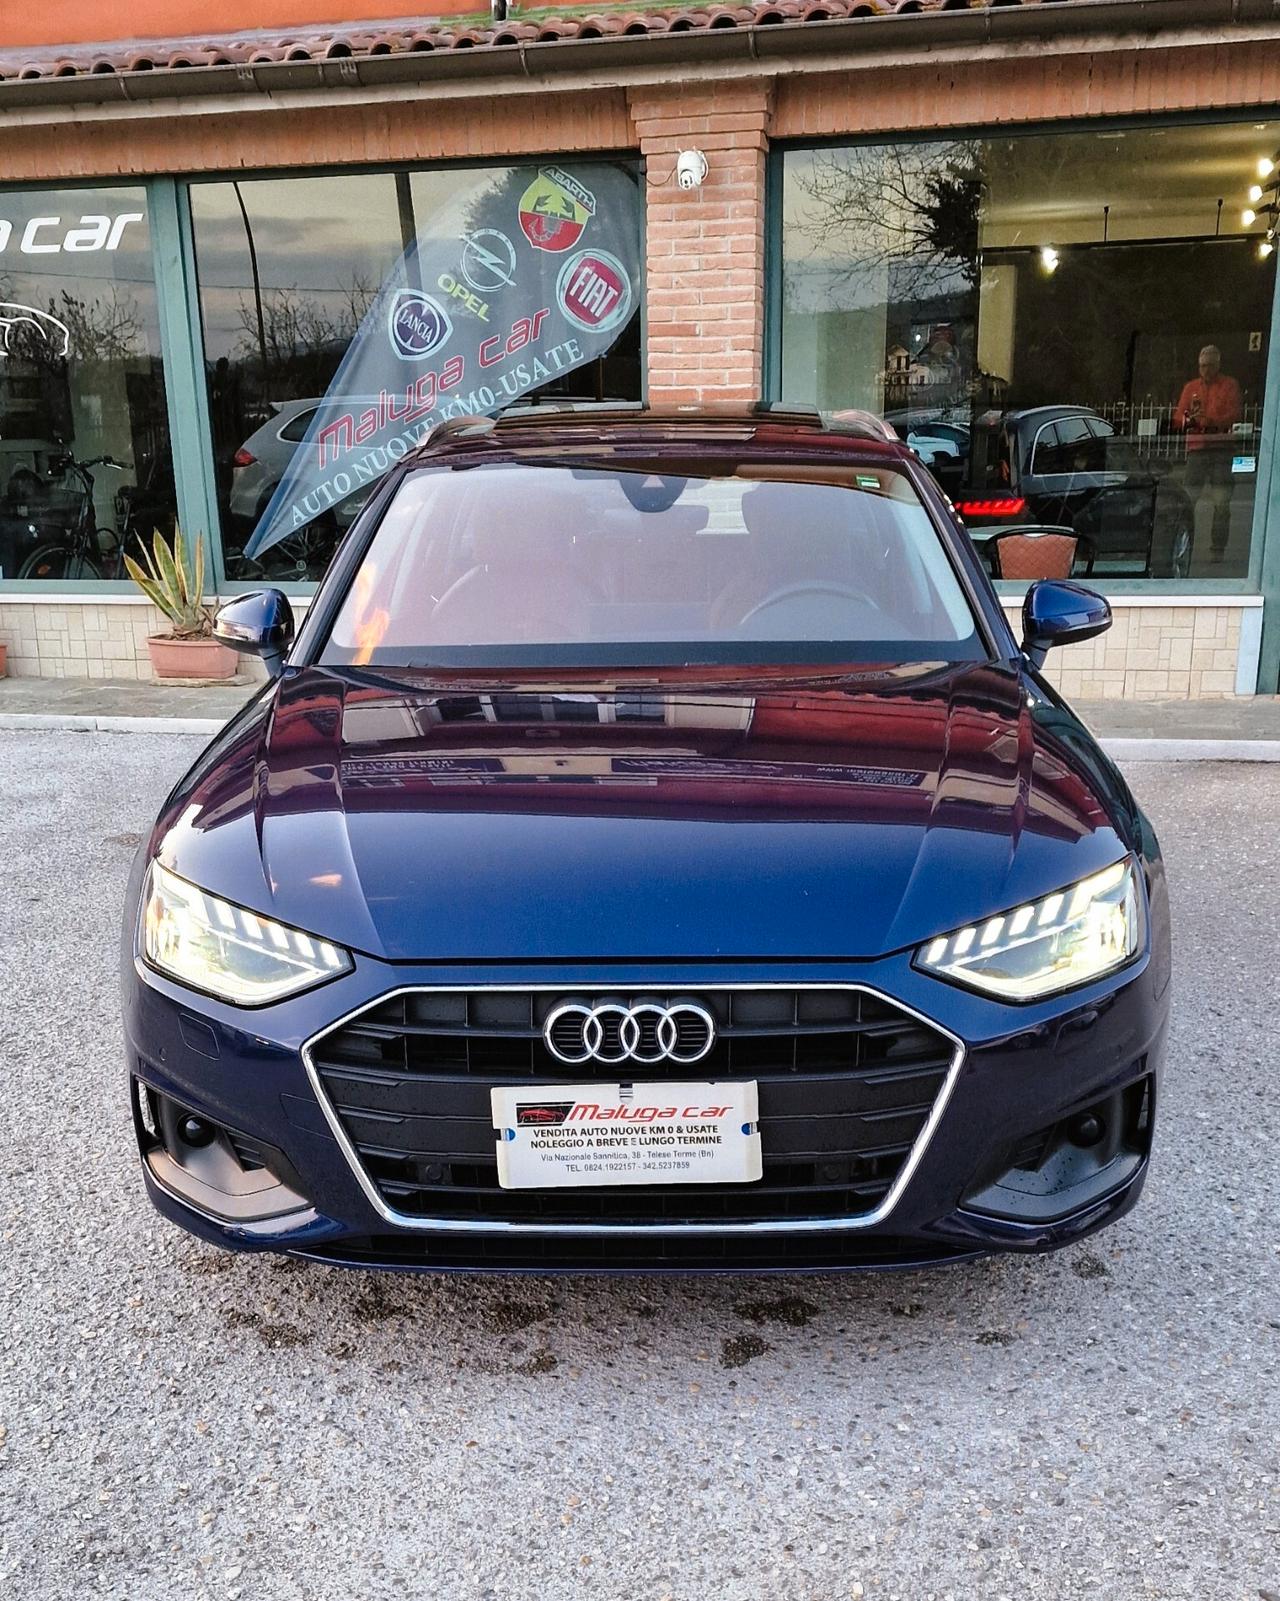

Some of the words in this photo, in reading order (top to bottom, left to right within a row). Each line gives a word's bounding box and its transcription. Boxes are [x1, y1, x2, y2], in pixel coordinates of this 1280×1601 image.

[545, 168, 593, 208] ABARTH
[20, 213, 144, 253] car
[437, 273, 490, 322] OPEL
[569, 266, 618, 318] FIAT
[398, 308, 433, 344] LANCIA
[318, 354, 465, 471] Maluga
[479, 307, 550, 369] car
[289, 472, 352, 526] AUTO
[533, 1128, 577, 1138] VENDITA
[580, 1127, 608, 1137] AUTO
[610, 1126, 647, 1136] NUOVE
[649, 1126, 666, 1135] KM
[668, 1126, 674, 1134] 0
[676, 1125, 684, 1134] &
[686, 1124, 718, 1134] USATE
[568, 1104, 678, 1123] Maluga
[681, 1106, 734, 1119] car
[531, 1139, 584, 1149] NOLEGGIO
[586, 1138, 594, 1147] A
[596, 1137, 628, 1147] BREVE
[631, 1138, 637, 1146] E
[640, 1136, 675, 1146] LUNGO
[677, 1135, 722, 1145] TERMINE
[540, 1153, 553, 1162] Via
[554, 1152, 592, 1161] Nazionale
[593, 1151, 630, 1161] Sannitica,
[648, 1150, 672, 1159] Telese
[673, 1149, 697, 1158] Terme
[698, 1148, 715, 1159] (Bn)
